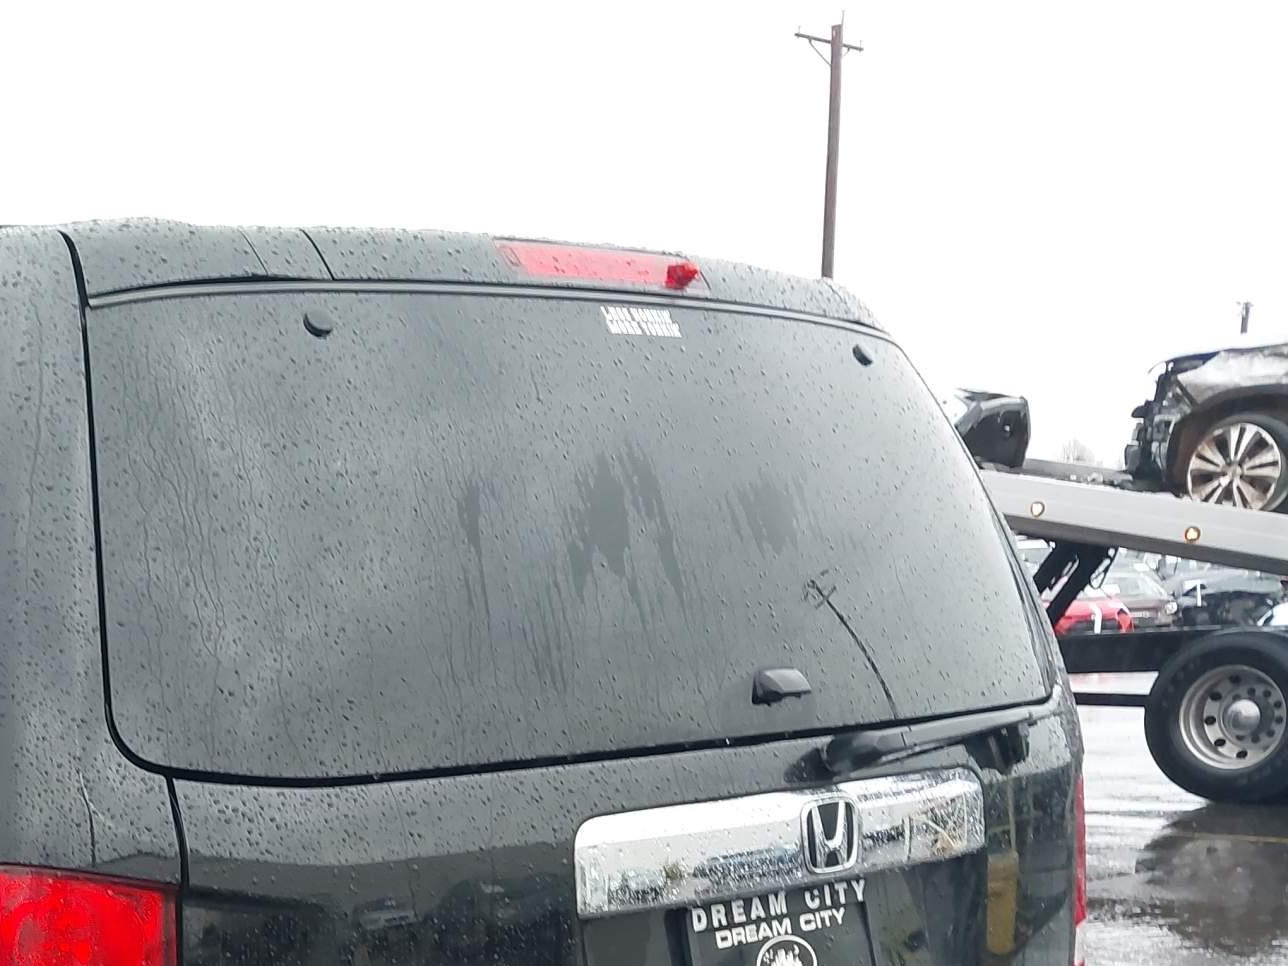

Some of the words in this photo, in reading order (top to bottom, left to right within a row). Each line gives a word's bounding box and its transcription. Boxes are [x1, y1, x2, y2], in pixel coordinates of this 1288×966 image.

[692, 891, 787, 932] DREAM
[804, 879, 866, 910] CITY
[715, 917, 793, 949] DREAM
[799, 907, 845, 932] CITY
